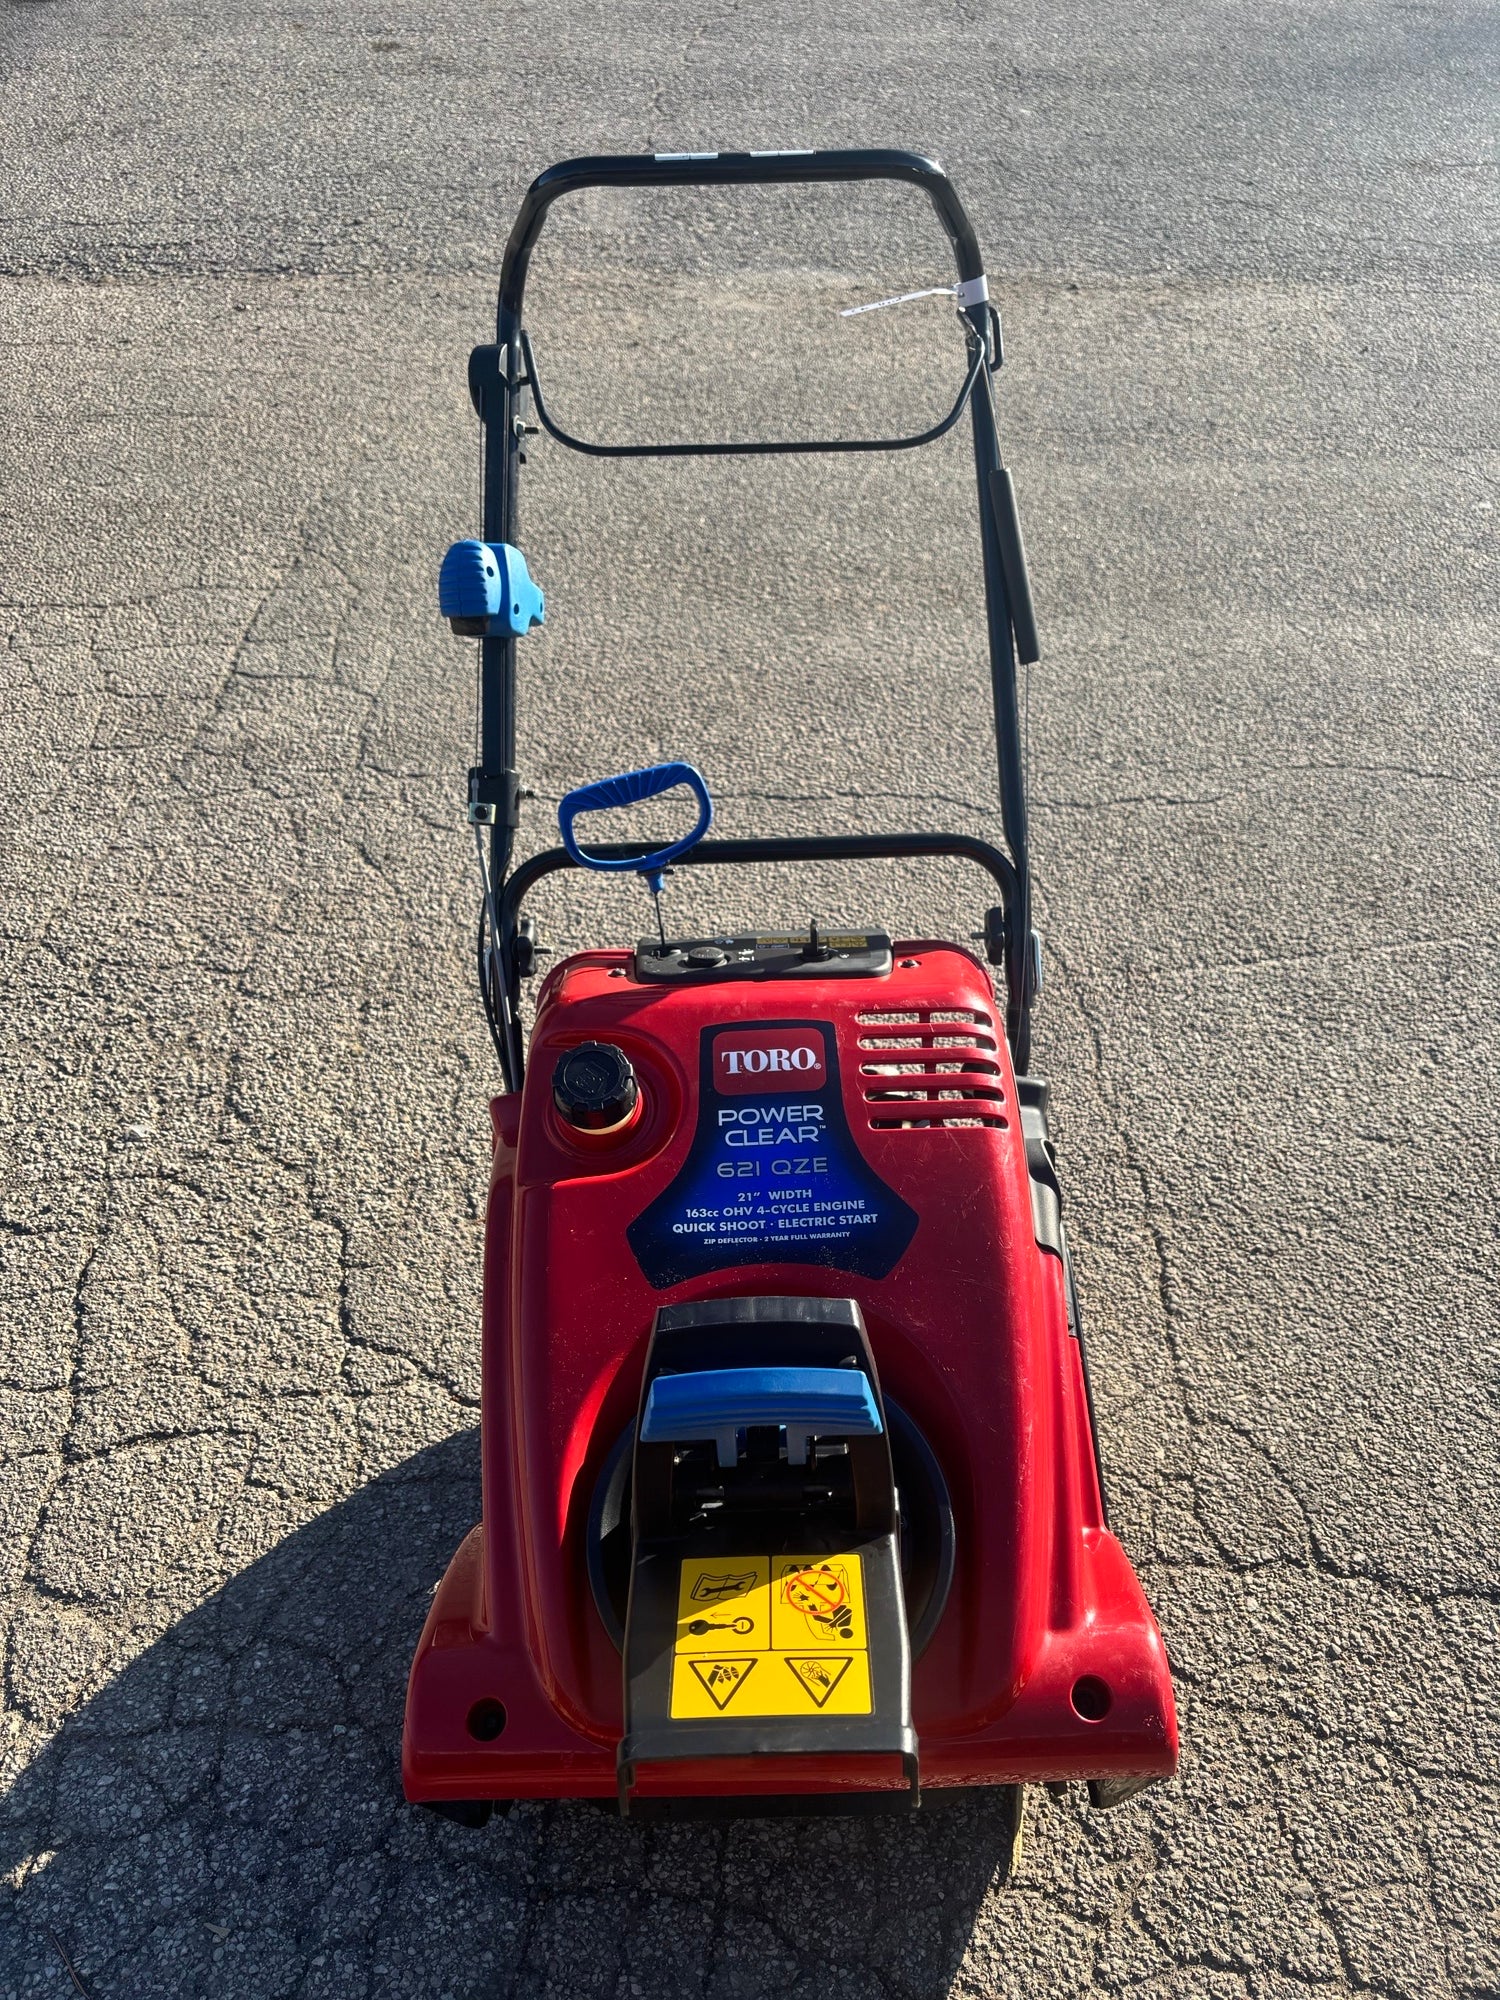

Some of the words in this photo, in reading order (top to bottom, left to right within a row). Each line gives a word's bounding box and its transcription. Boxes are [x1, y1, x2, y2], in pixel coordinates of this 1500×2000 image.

[721, 1047, 817, 1075] TORO
[718, 1104, 824, 1126] POWER
[725, 1125, 820, 1147] CLEAR
[716, 1160, 760, 1178] 621
[771, 1157, 828, 1175] QZE
[768, 1189, 812, 1200] WIDTH
[685, 1208, 719, 1218] 163cc
[722, 1206, 753, 1217] OHV
[756, 1203, 810, 1215] 4-CYCLE
[813, 1199, 866, 1212] ENGINE
[672, 1222, 716, 1234] QUICK
[719, 1220, 766, 1232] SHOOT
[778, 1216, 836, 1228] ELECTRIC
[839, 1213, 878, 1225] START
[717, 1236, 758, 1244] DEFLECTOR
[809, 1231, 851, 1239] WARRANTY
